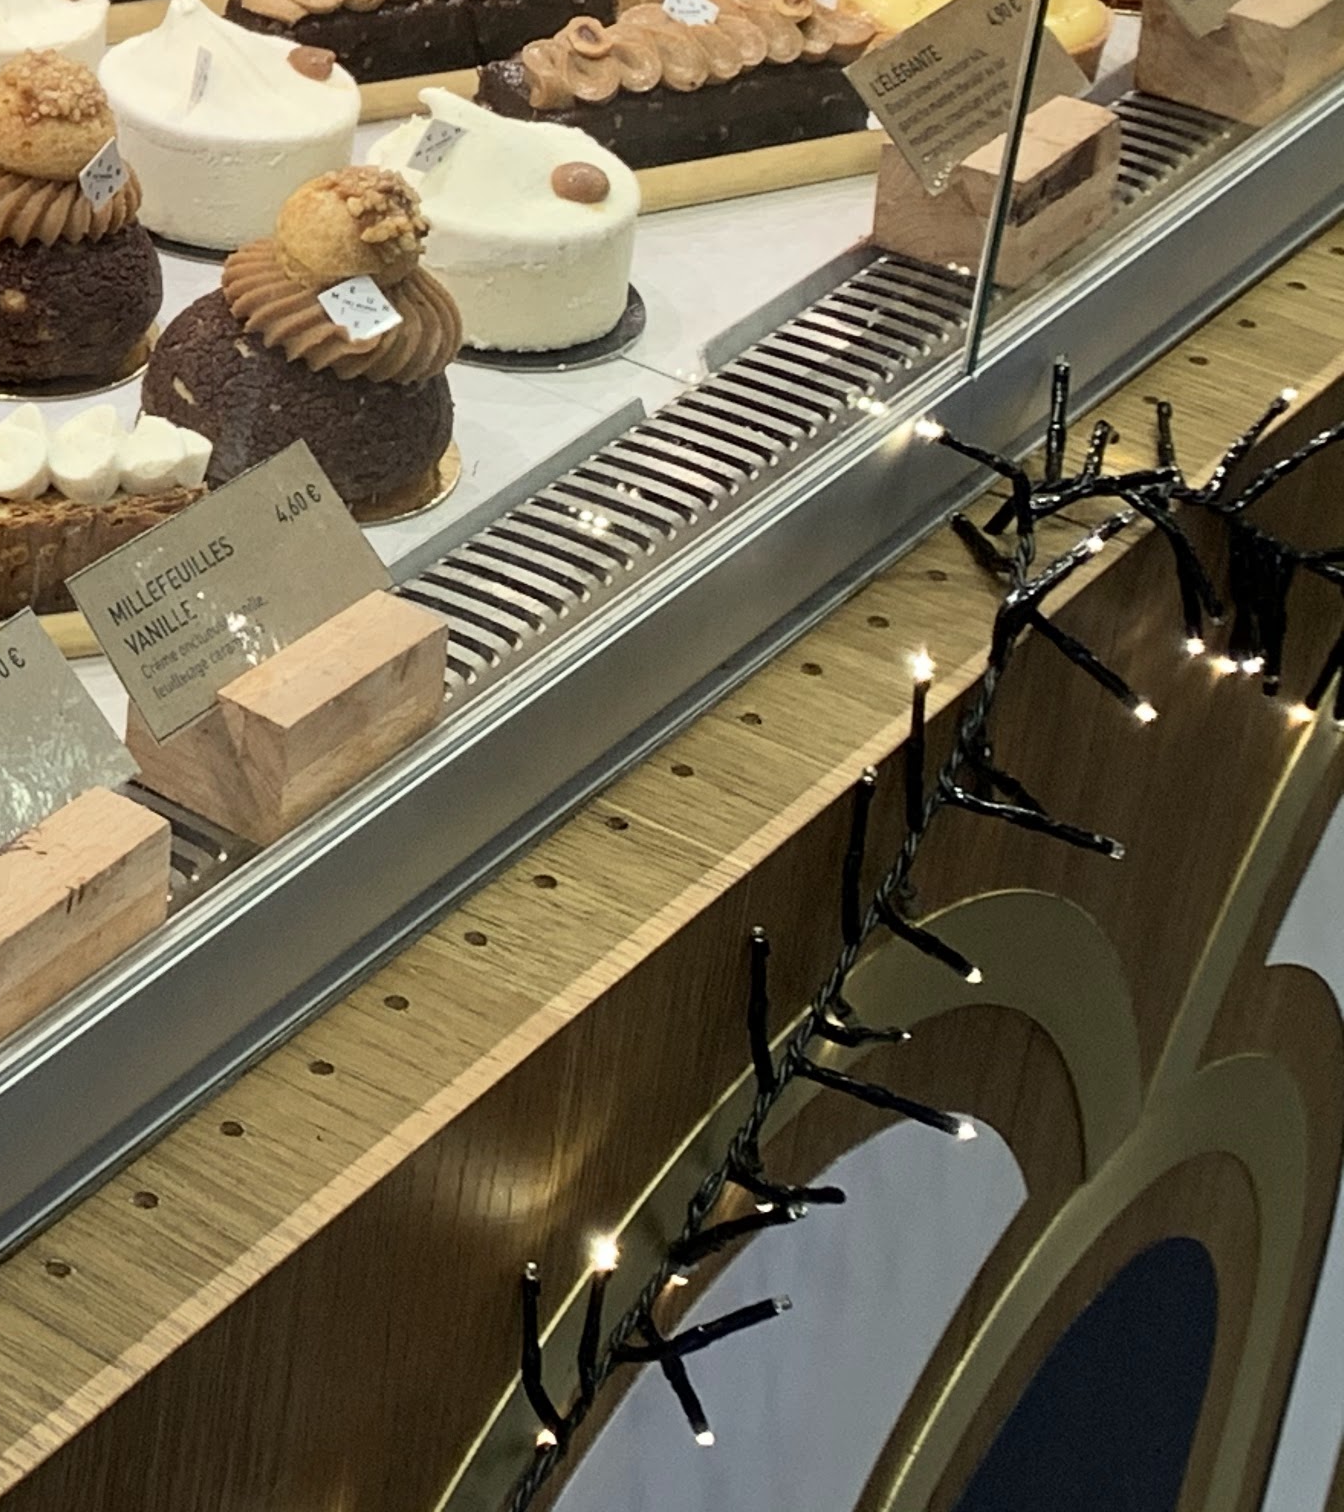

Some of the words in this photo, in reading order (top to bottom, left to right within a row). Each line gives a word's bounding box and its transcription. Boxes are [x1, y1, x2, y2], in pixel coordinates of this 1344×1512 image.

[274, 490, 310, 525] 4,60
[307, 483, 322, 504] €
[107, 535, 236, 627] MILLEFEUILLES
[124, 598, 199, 657] VANILLE
[9, 646, 27, 670] €
